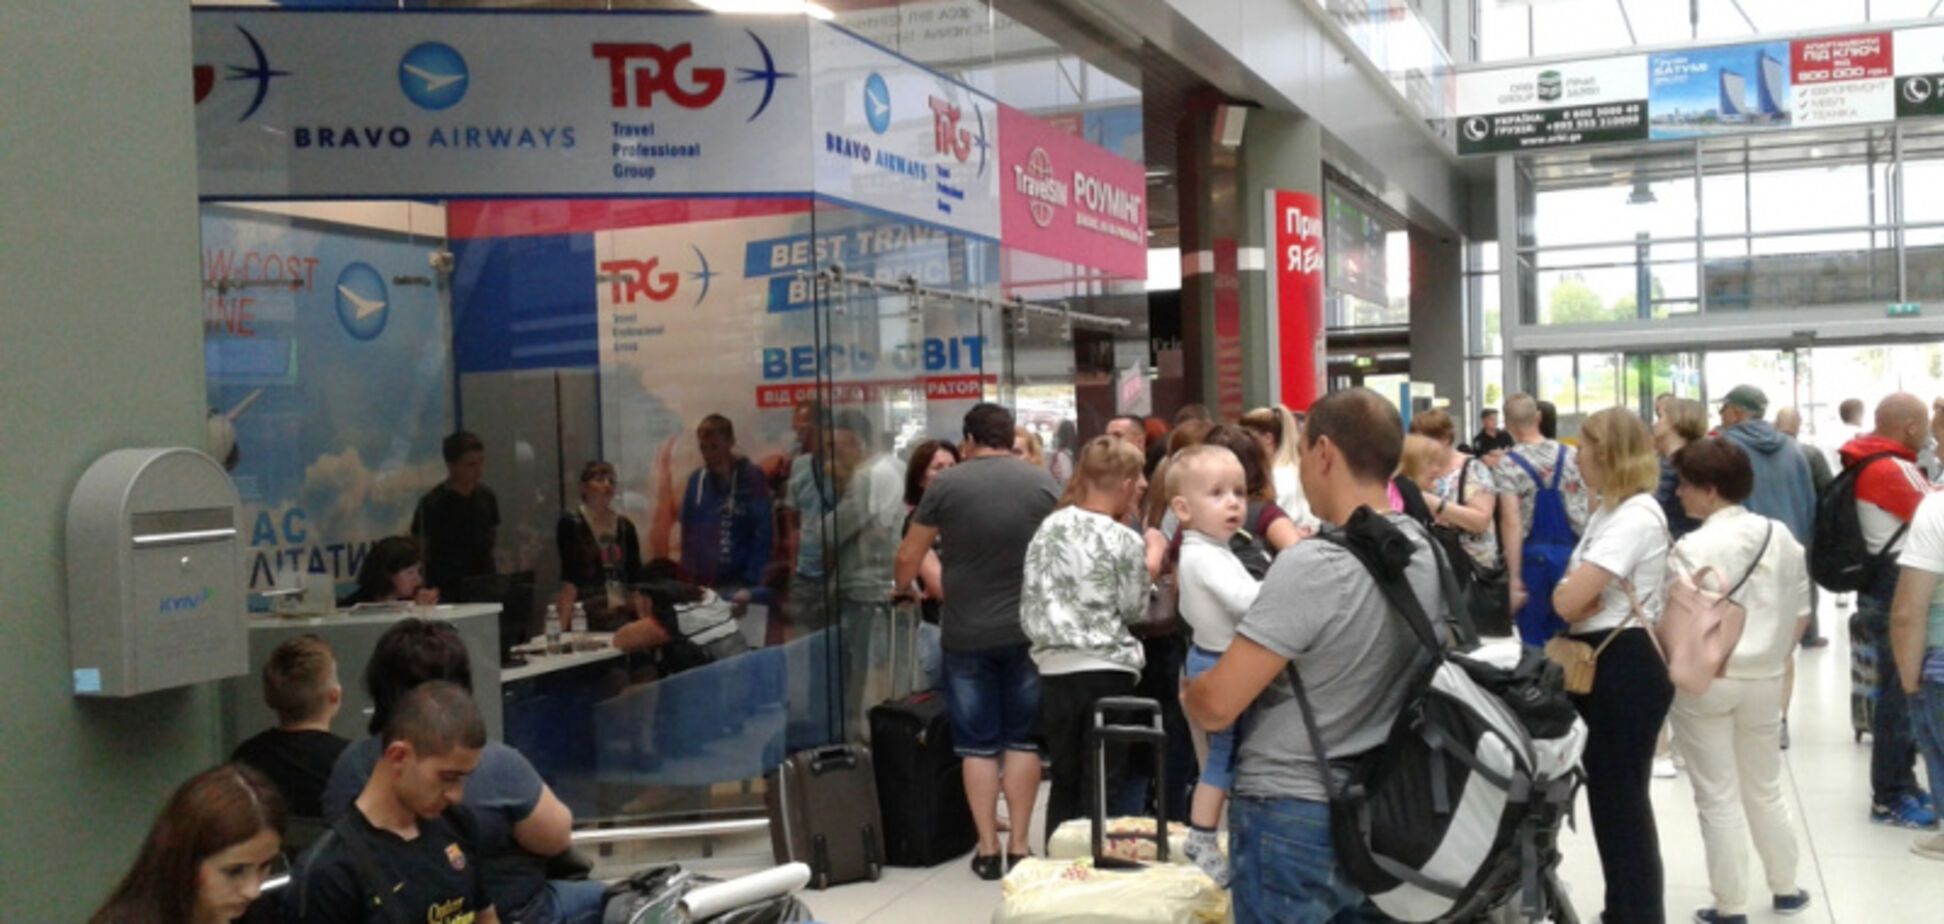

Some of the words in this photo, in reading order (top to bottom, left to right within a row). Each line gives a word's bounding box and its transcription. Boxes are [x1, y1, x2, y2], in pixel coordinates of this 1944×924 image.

[591, 42, 727, 110] TPG
[294, 126, 411, 148] BRAVO
[428, 126, 577, 148] AIRWAYS
[612, 121, 655, 137] Travel
[612, 142, 701, 158] Professional
[826, 131, 871, 164] BRAVO
[612, 162, 656, 180] Group
[1074, 170, 1142, 224] РОУМІНГ
[769, 235, 847, 270] BEST
[600, 256, 679, 304] TPG
[763, 342, 877, 380] ВЕСЬ
